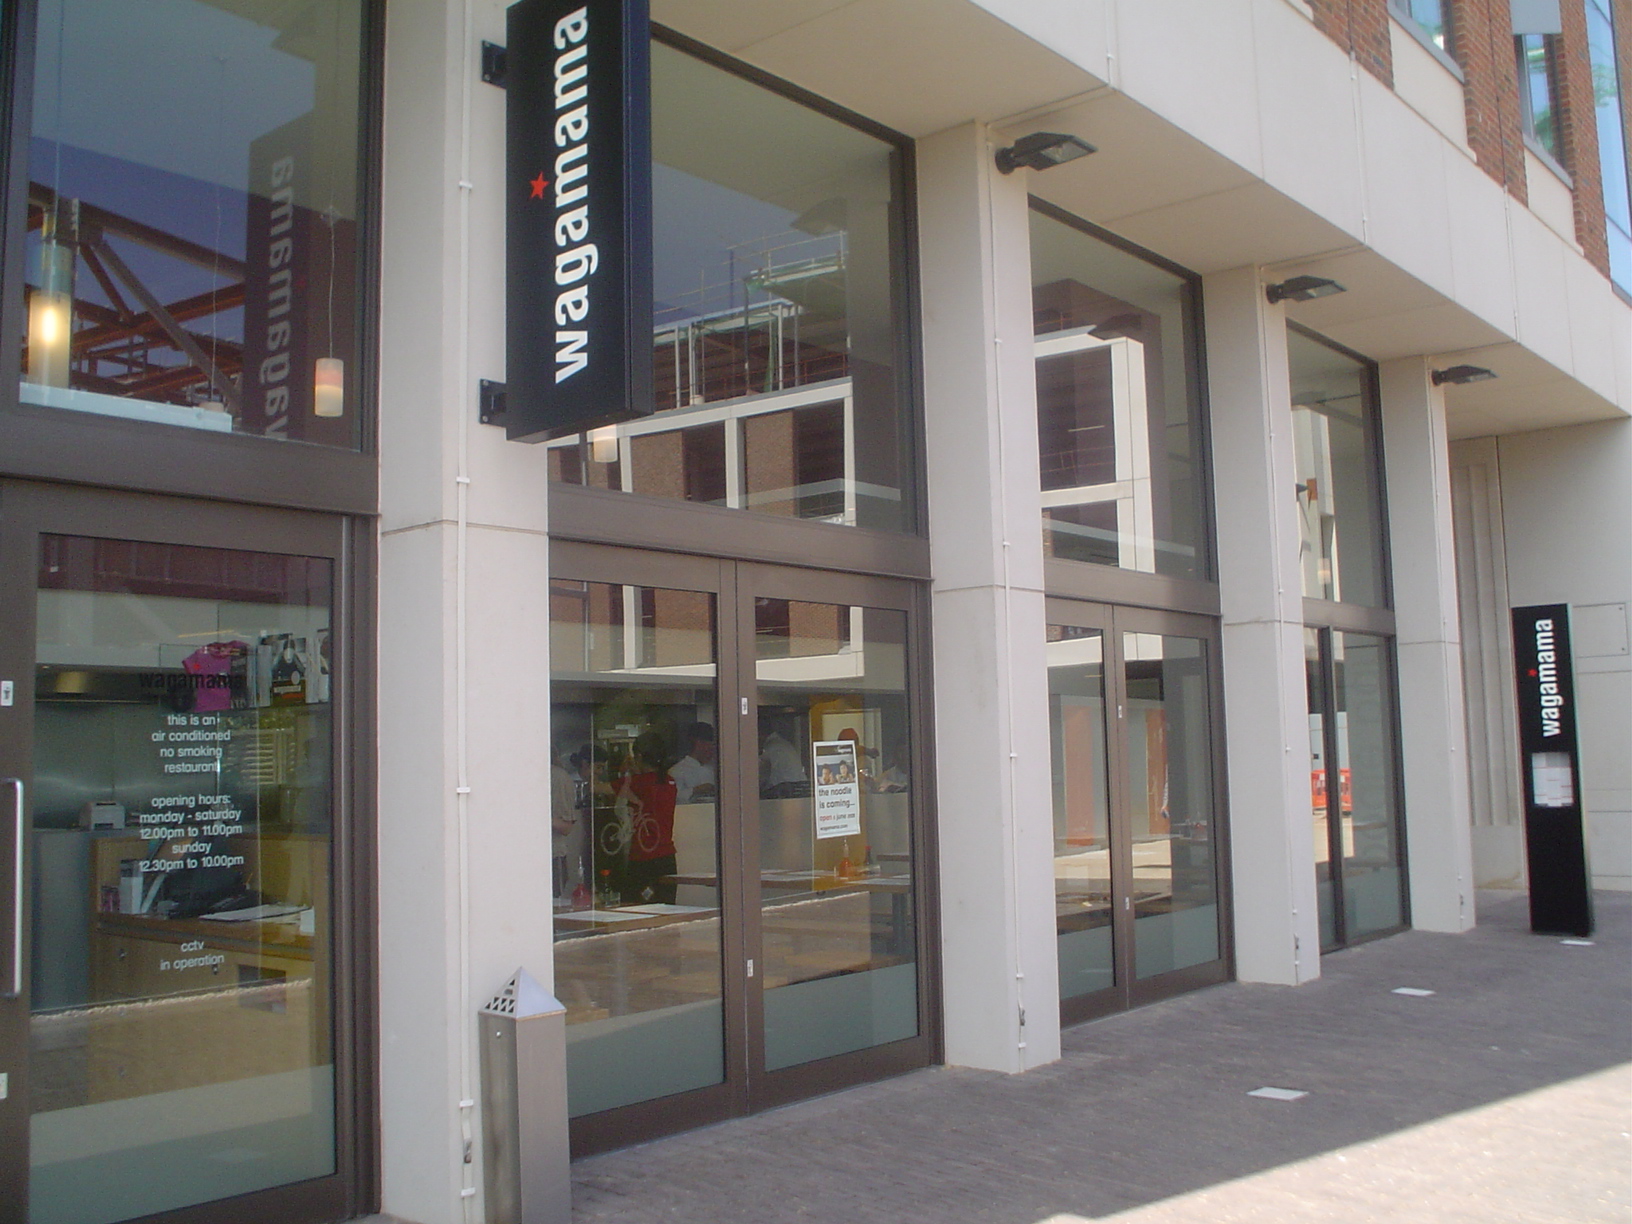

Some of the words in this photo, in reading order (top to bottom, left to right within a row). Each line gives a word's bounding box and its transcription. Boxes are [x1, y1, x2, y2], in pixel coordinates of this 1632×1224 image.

[554, 5, 599, 385] wagamama
[138, 672, 245, 693] wagamama
[1535, 618, 1564, 738] wagamama
[167, 714, 187, 726] this
[190, 714, 199, 725] is
[202, 716, 216, 726] an
[151, 730, 165, 742] air
[168, 730, 231, 742] conditioned
[160, 748, 174, 758] no
[178, 745, 223, 759] smoking
[164, 761, 221, 773] restaurant
[819, 787, 829, 796] the
[830, 786, 852, 796] noodle
[151, 795, 195, 809] opening
[198, 794, 231, 805] hours:
[819, 801, 825, 809] is
[139, 810, 185, 824] monday
[195, 809, 242, 823] saturday
[139, 827, 185, 841] 12.00pm
[187, 826, 198, 837] to
[202, 824, 243, 838] 11.00pm
[171, 841, 212, 855] sunday
[139, 858, 184, 873] 12.30pm
[187, 857, 198, 869] to
[201, 855, 244, 870] 10.00pm
[180, 940, 205, 953] cctv
[160, 959, 170, 971] in
[173, 953, 225, 971] operation
